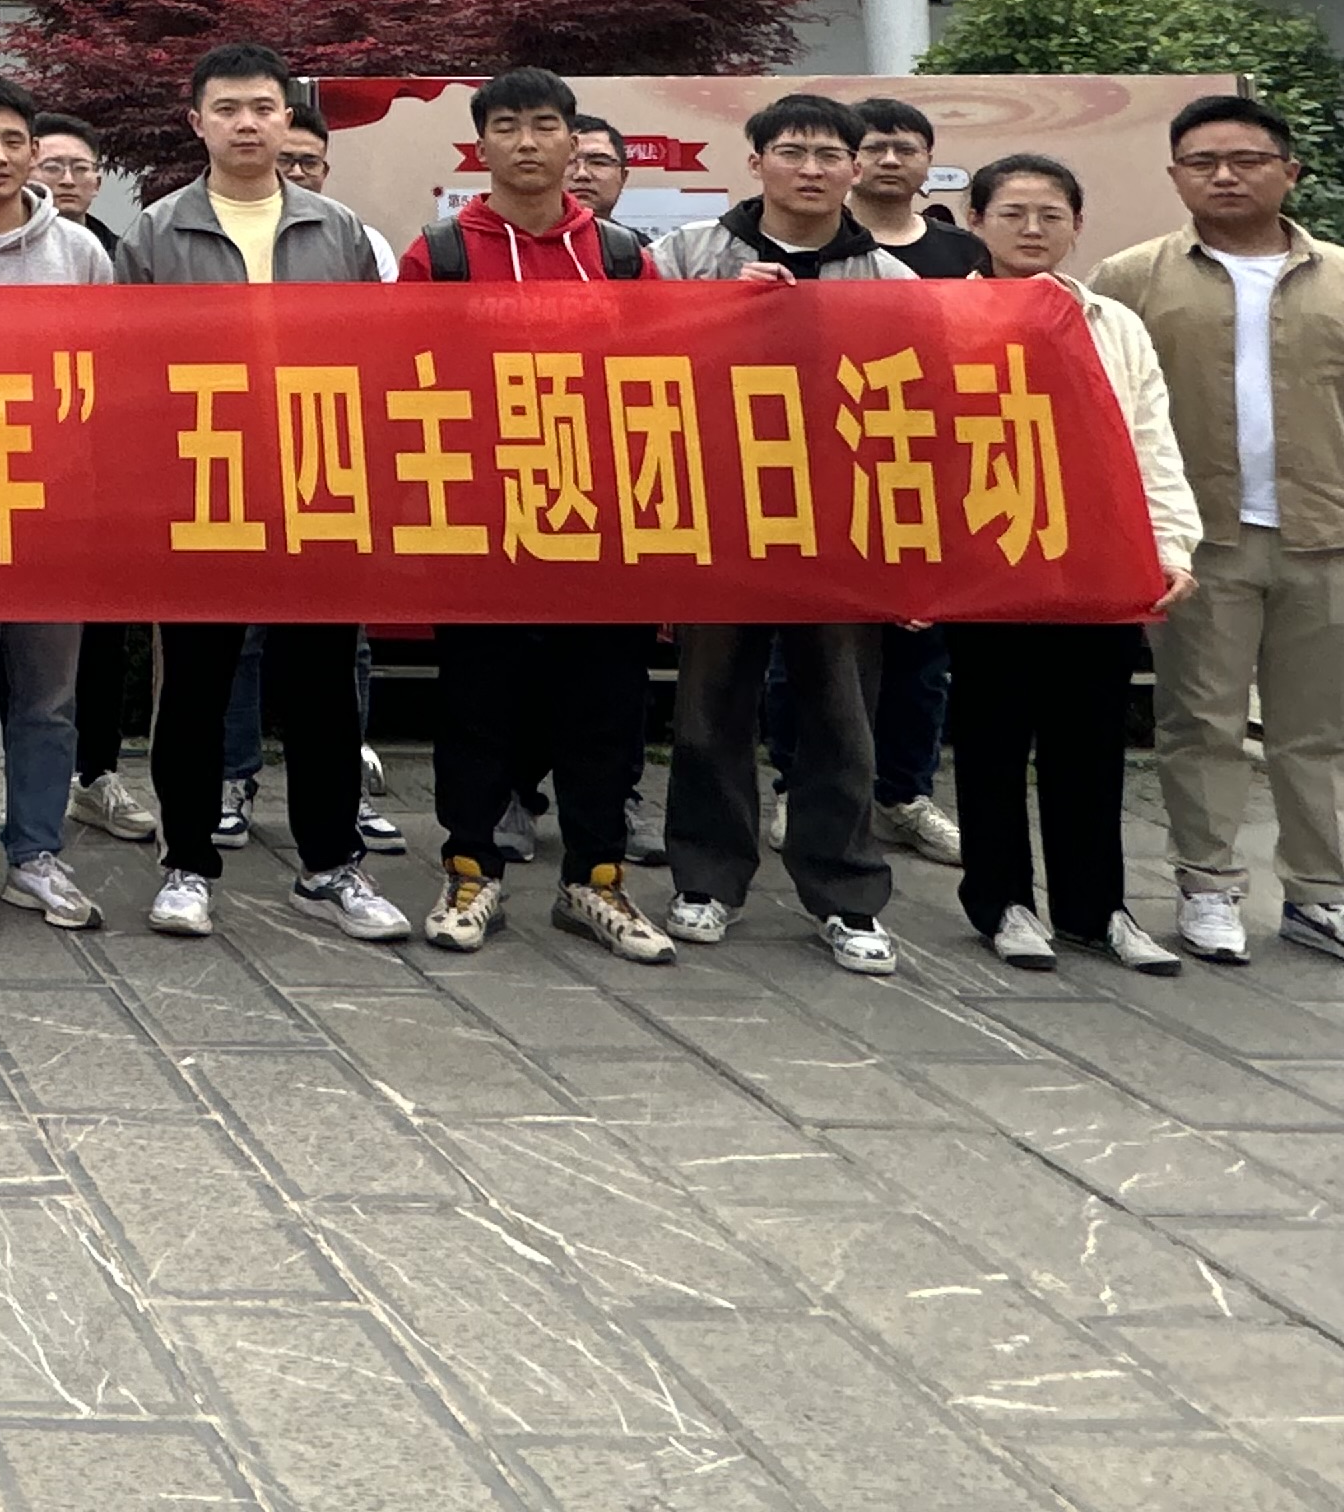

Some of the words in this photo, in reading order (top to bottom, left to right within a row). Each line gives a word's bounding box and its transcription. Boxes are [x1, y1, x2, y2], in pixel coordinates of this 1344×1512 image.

[168, 344, 1069, 566] 五四主题团日活动
